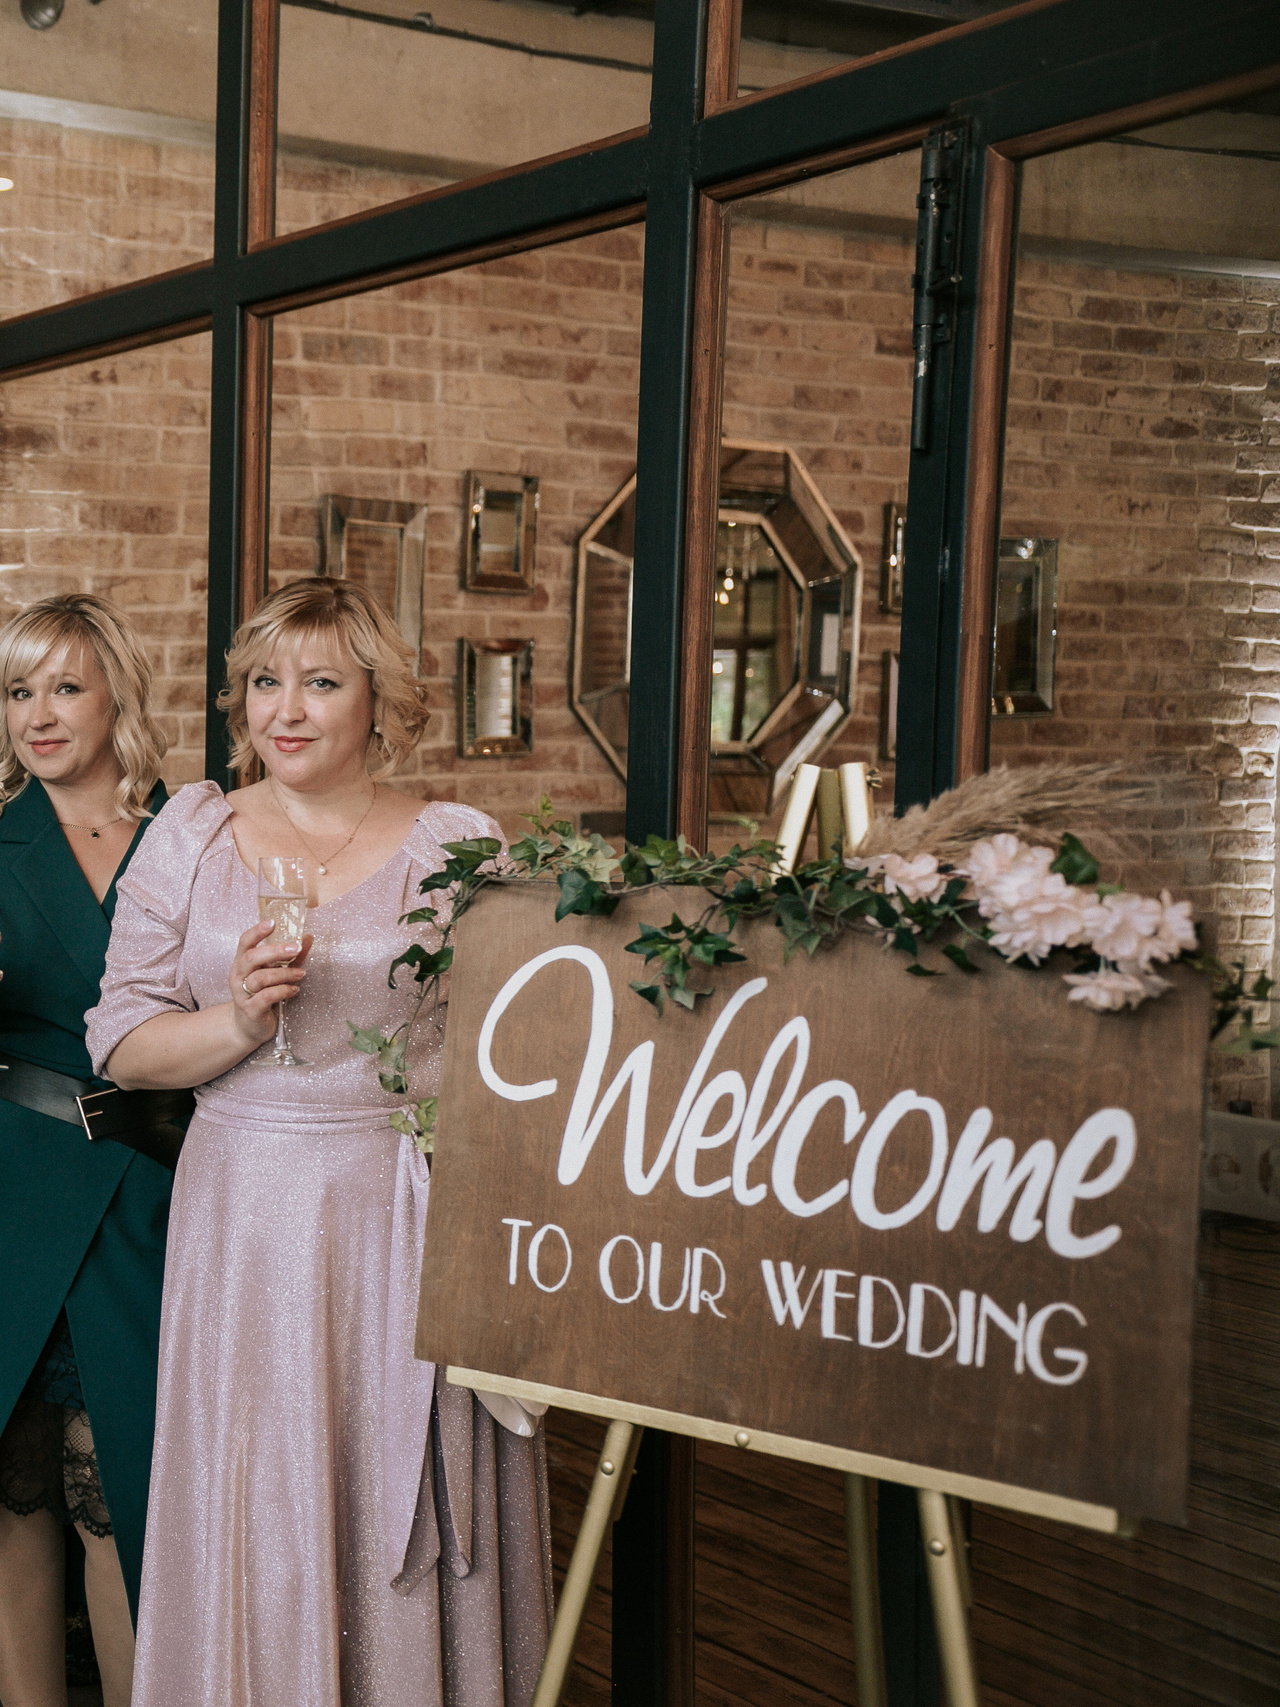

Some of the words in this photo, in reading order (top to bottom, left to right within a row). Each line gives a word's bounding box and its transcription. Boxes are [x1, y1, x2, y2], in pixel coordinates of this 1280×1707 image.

[477, 944, 1137, 1259] Welcome
[502, 1218, 572, 1293] TO
[599, 1234, 727, 1319] OUR
[761, 1259, 1088, 1386] WEDDING
